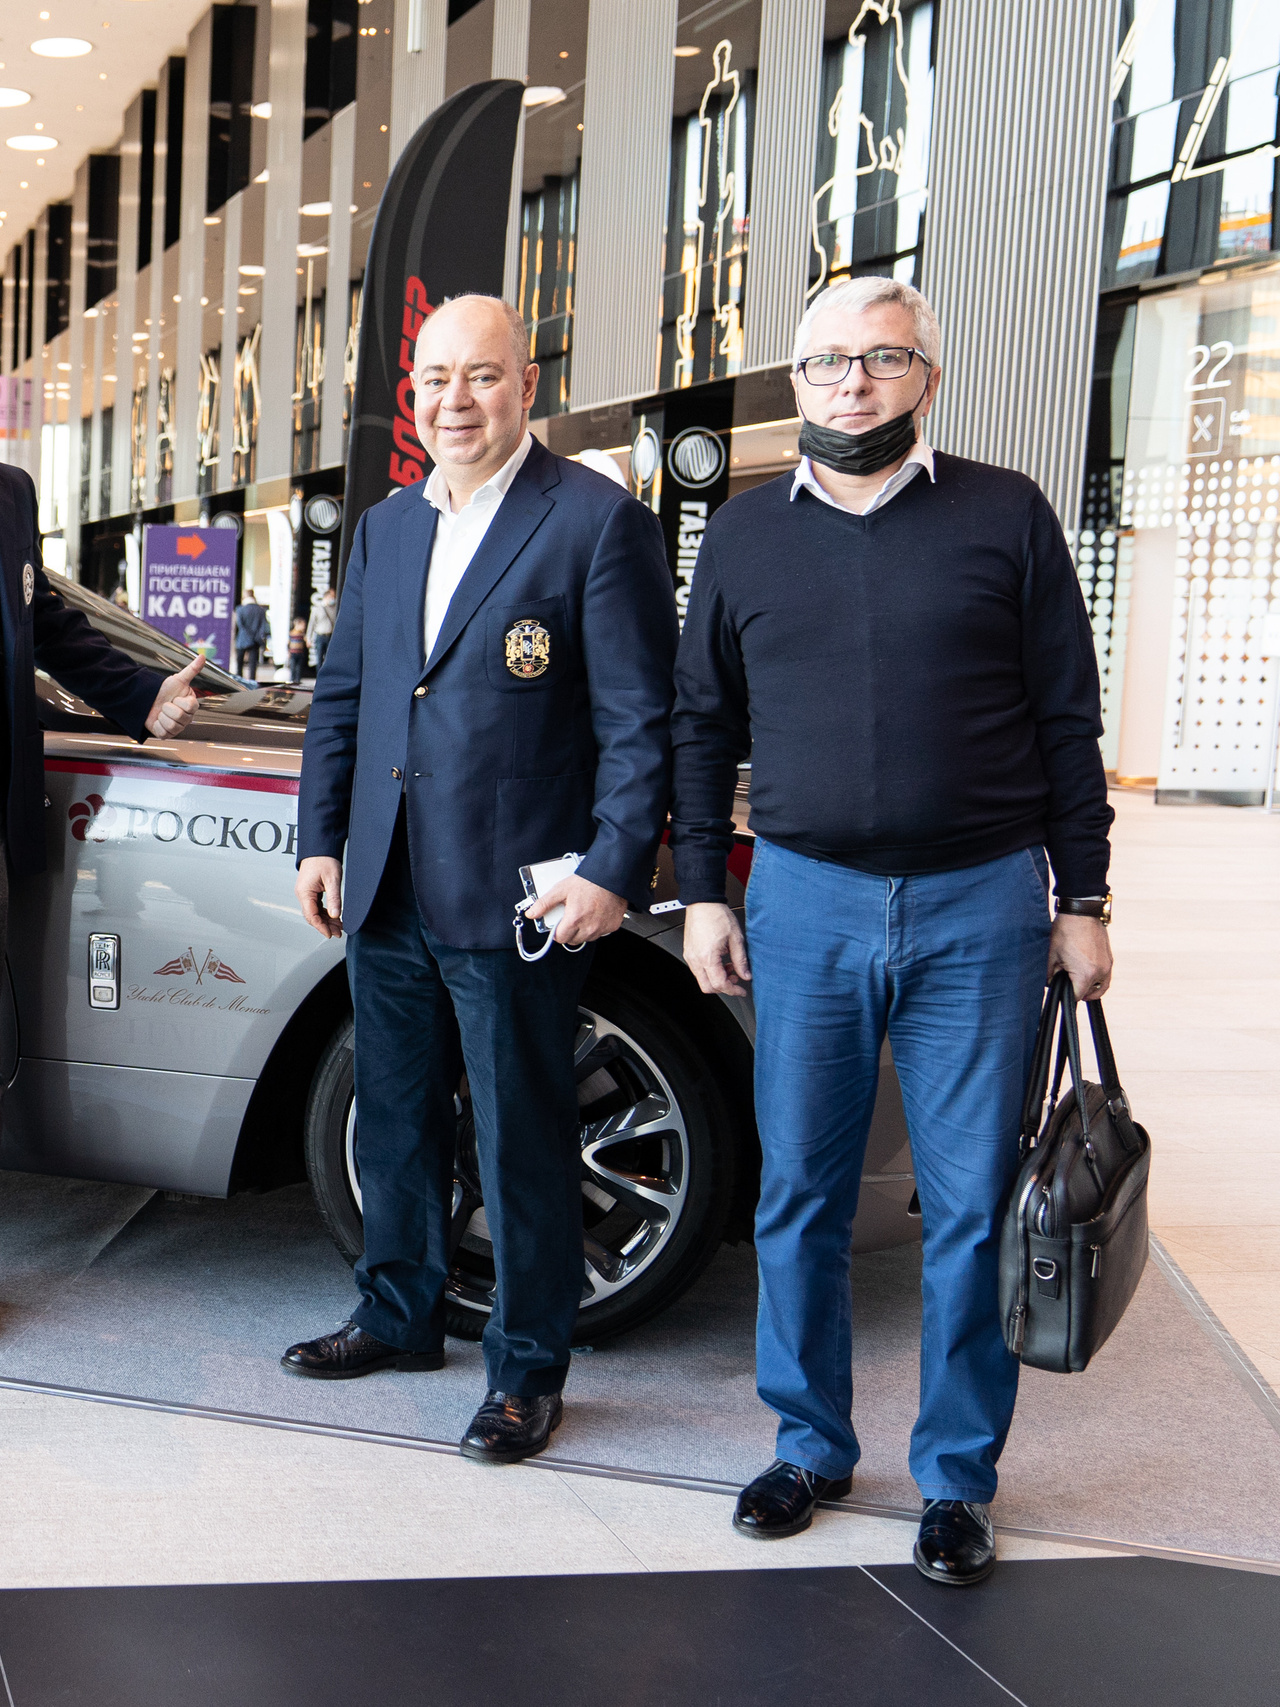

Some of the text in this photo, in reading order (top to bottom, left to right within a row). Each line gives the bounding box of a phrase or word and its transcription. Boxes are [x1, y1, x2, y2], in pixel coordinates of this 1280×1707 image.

[1183, 340, 1234, 393] 22
[149, 563, 230, 577] ПРИГЛАШАЕМ
[674, 501, 708, 634] ГАЗПРО
[149, 577, 230, 594] ПОСЕТИТЬ
[148, 594, 229, 619] КАФЕ
[126, 984, 271, 1014] Yacht Club de Monaco
